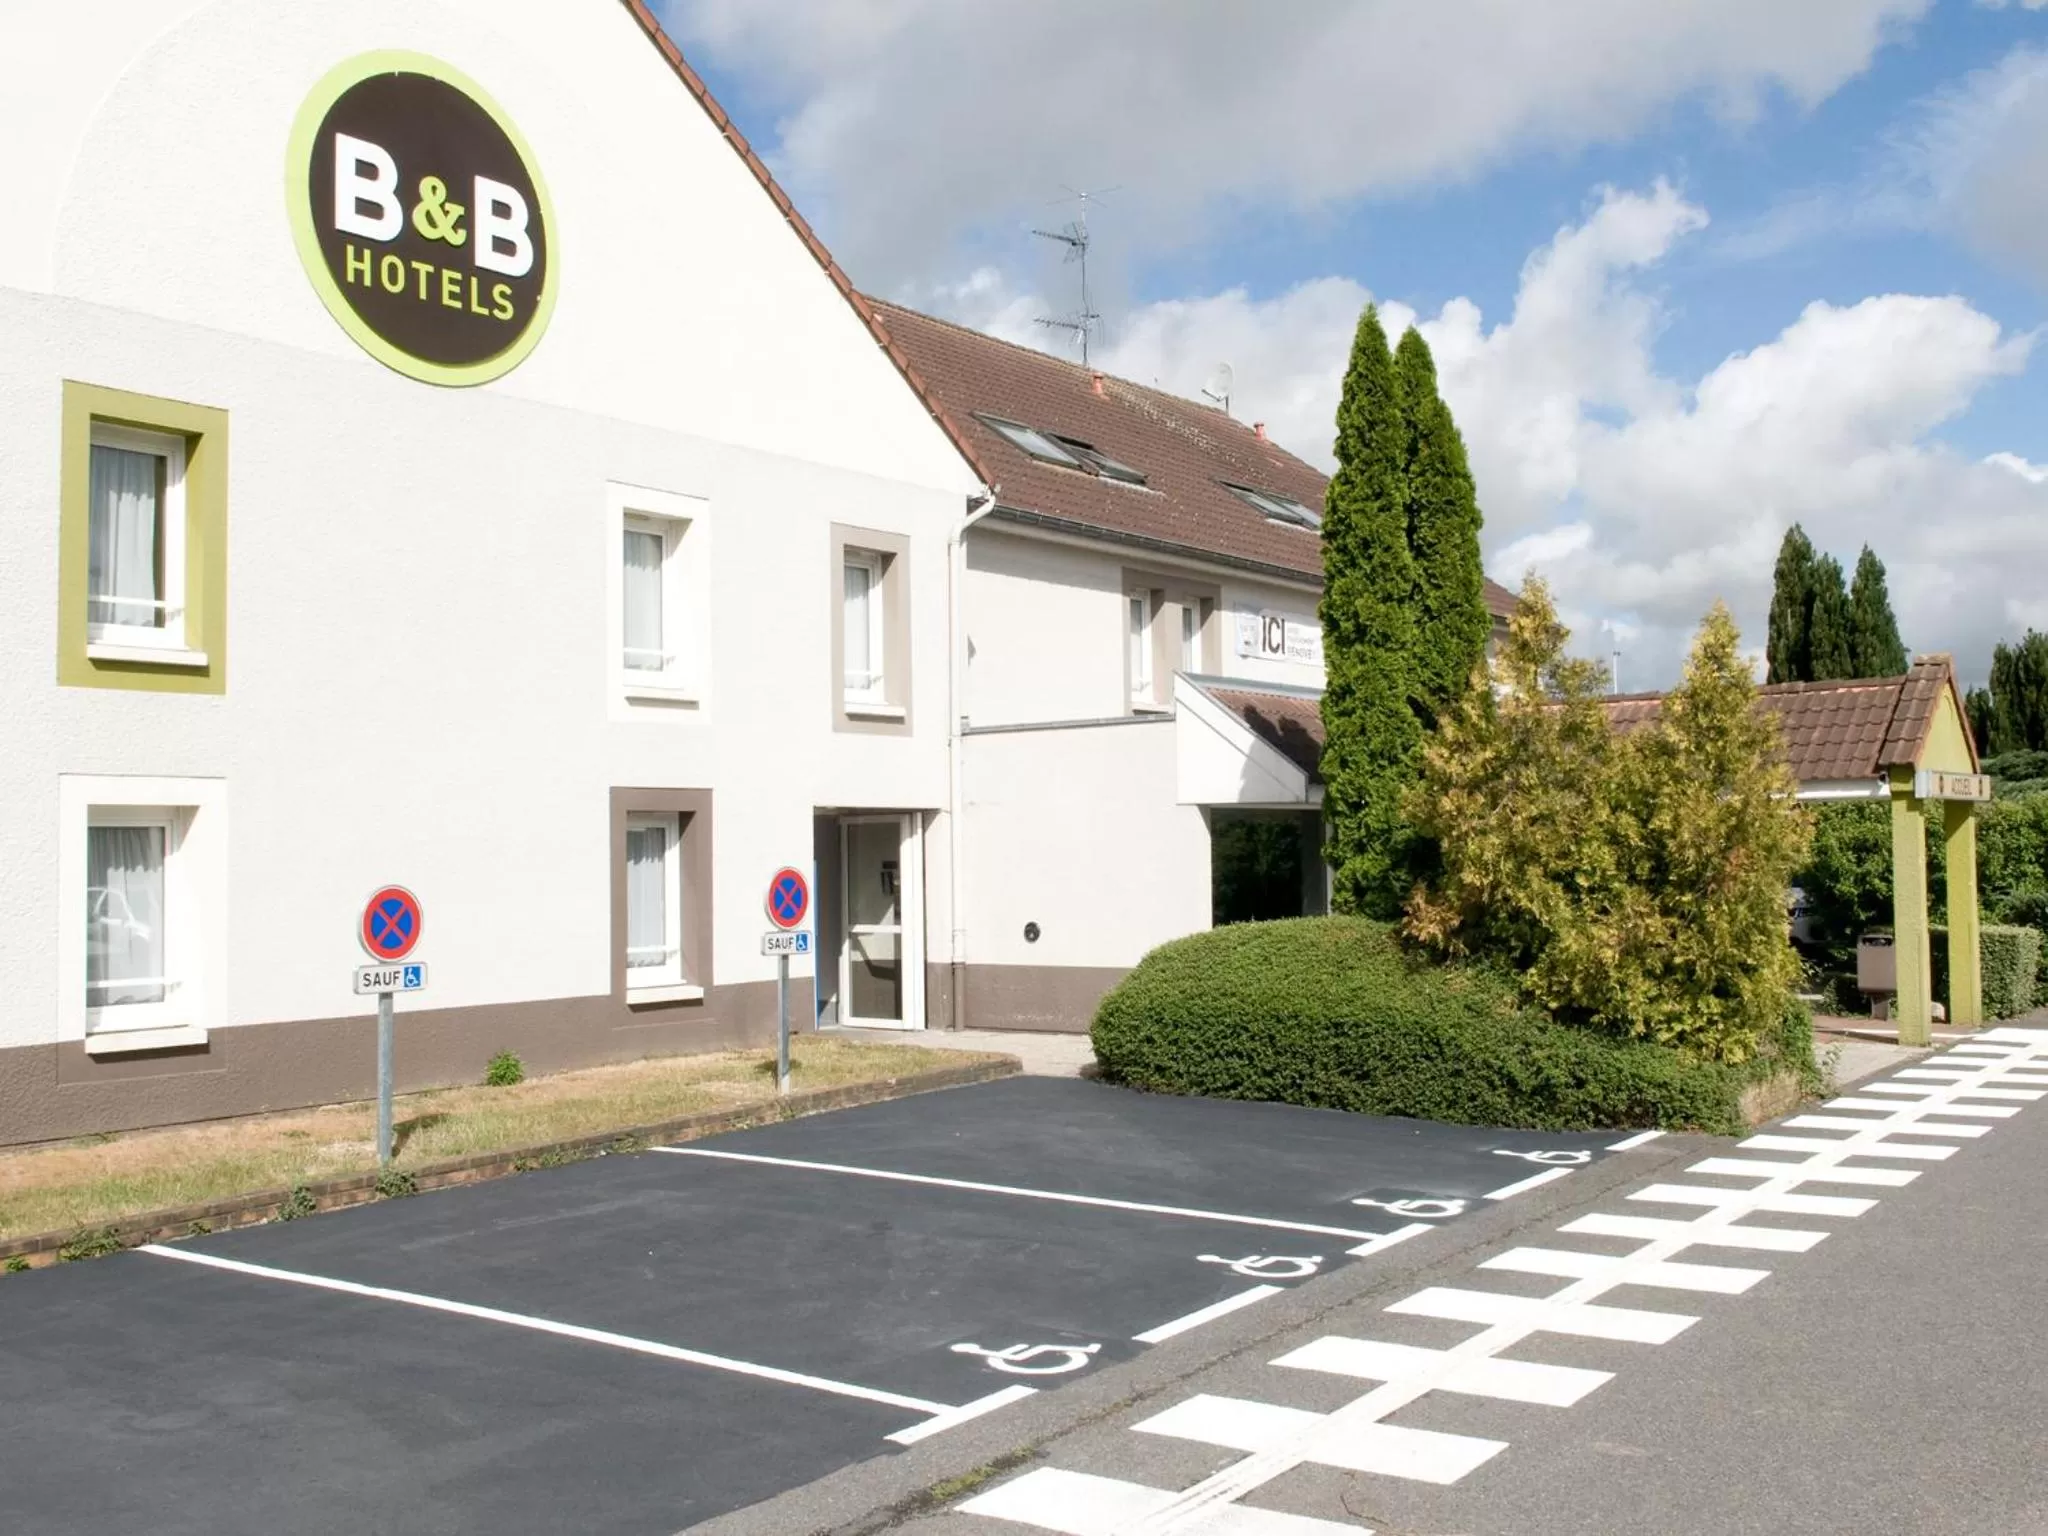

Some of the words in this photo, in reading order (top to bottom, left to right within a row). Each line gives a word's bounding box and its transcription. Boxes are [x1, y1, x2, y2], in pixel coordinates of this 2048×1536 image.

[335, 132, 534, 277] B&B
[346, 244, 514, 321] HOTELS
[1262, 615, 1286, 655] ICI
[767, 936, 794, 950] SAUF
[362, 970, 401, 987] SAUF
